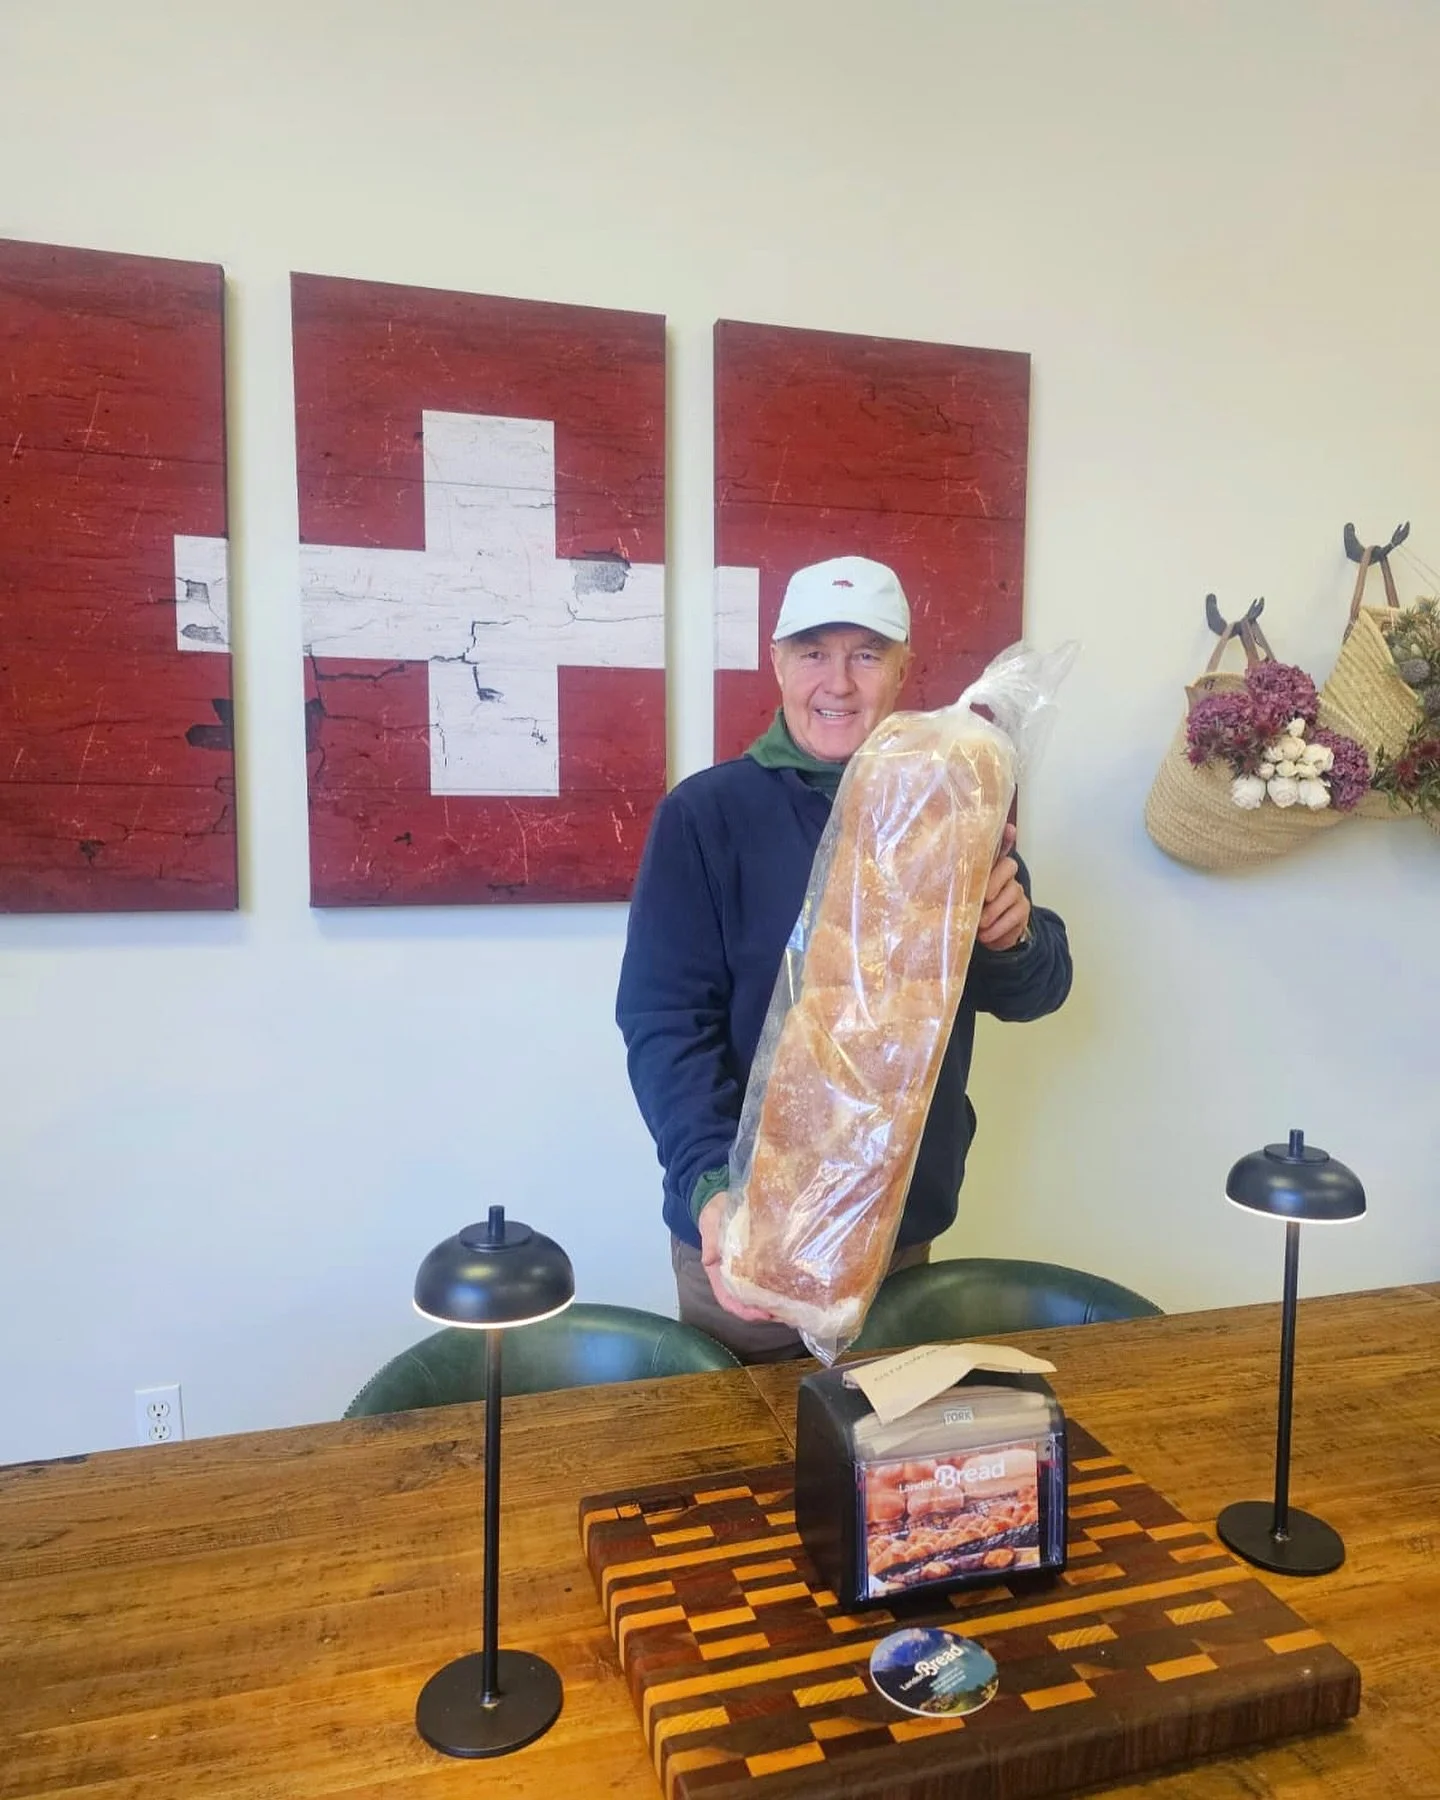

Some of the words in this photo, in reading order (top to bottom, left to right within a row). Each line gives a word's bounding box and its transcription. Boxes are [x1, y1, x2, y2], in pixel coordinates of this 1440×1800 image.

[946, 1410, 972, 1423] TORK
[934, 1457, 1005, 1489] Bread
[914, 1643, 964, 1677] Bread
